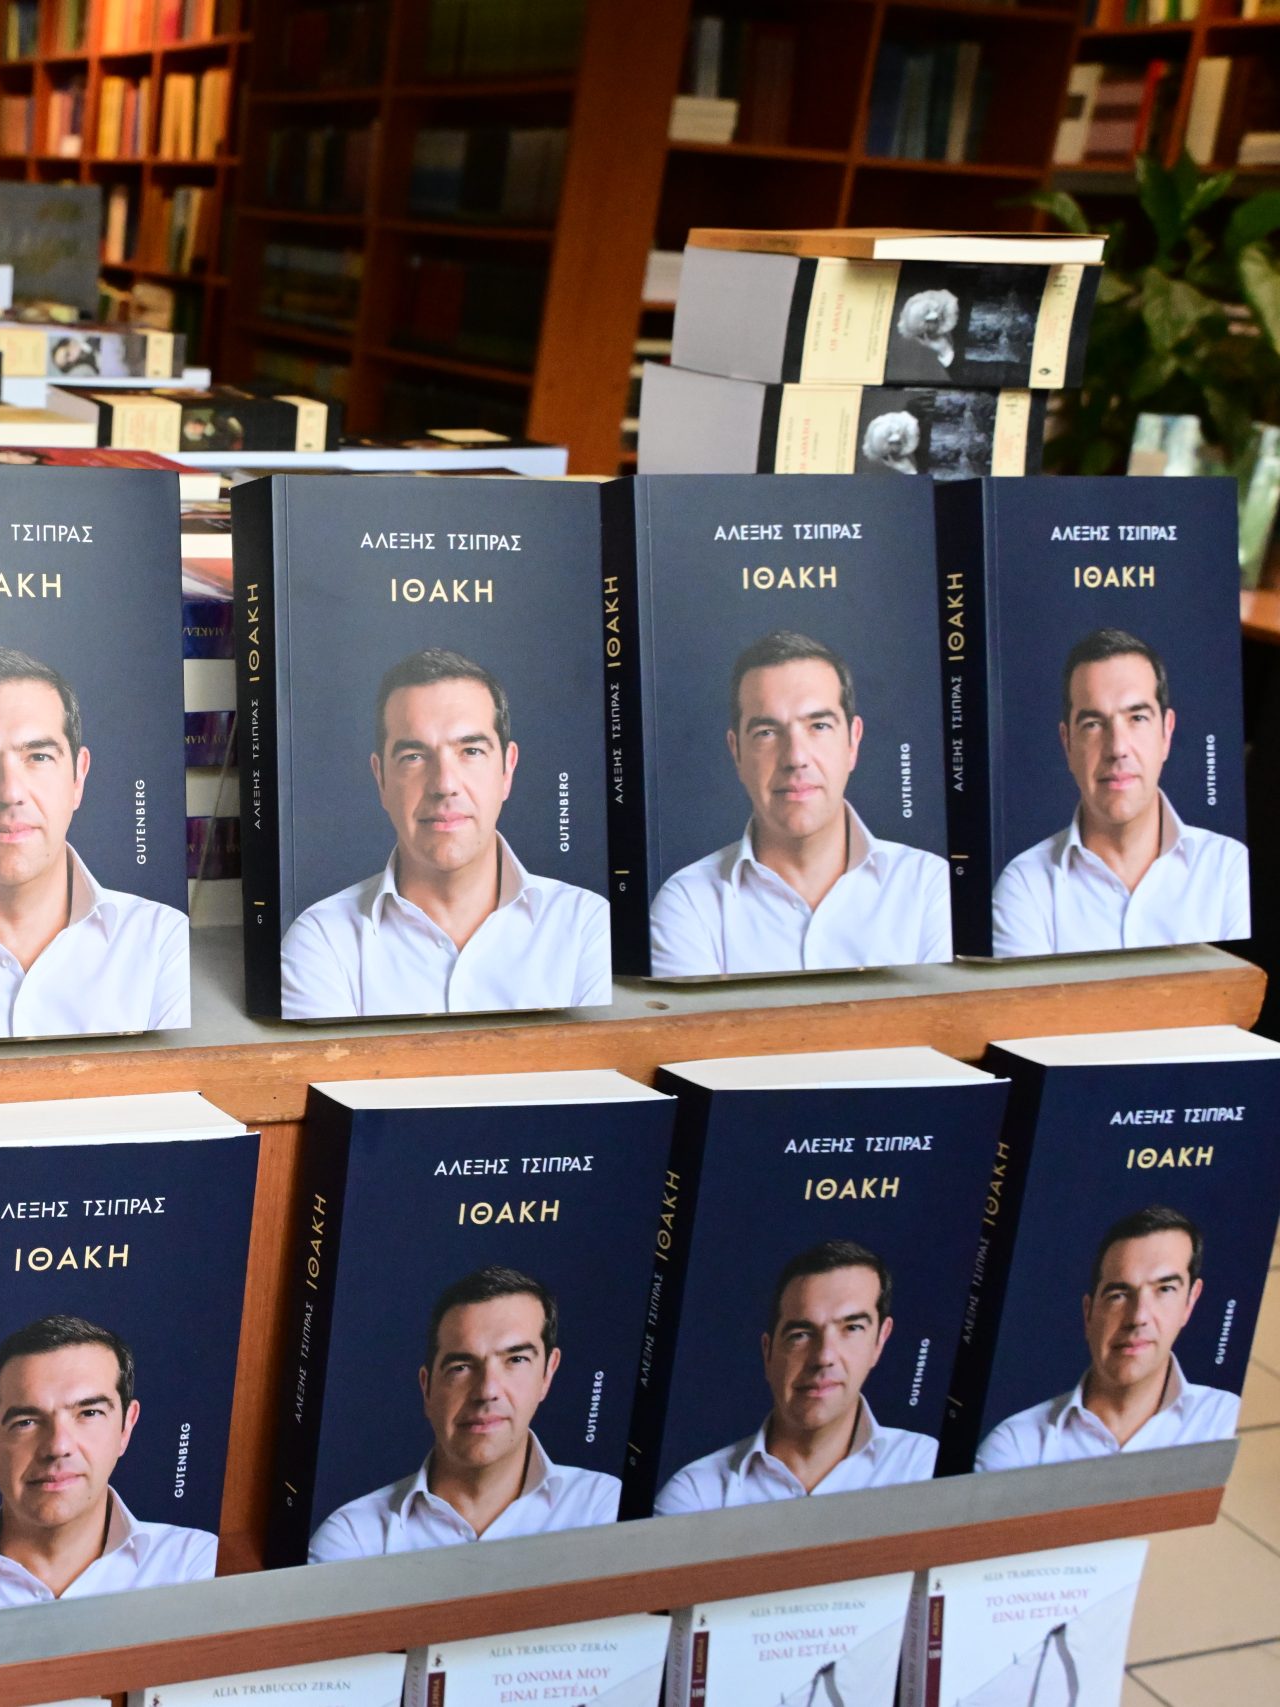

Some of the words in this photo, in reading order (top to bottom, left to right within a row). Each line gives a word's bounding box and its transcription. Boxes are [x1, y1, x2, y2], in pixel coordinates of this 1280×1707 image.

[11, 524, 93, 542] ΤΣΙΠΡΑΣ
[361, 533, 435, 549] ΑΛΕΞΗΣ
[447, 534, 521, 551] ΤΣΙΠΡΑΣ
[714, 525, 783, 540] ΑΛΕΞΗΣ
[793, 524, 862, 539] ΤΣΙΠΡΑΣ
[1051, 526, 1110, 541] ΑΛΕΞΗΣ
[1118, 526, 1177, 540] ΤΣΙΠΡΑΣ
[392, 579, 492, 602] ΙΘΑΚΗ
[743, 566, 836, 589] ΙΘΑΚΗ
[1075, 566, 1154, 588] ΙΘΑΚΗ
[246, 583, 260, 682] ΙΘΑΚΗ
[603, 576, 622, 668] ΙΘΑΚΗ
[946, 573, 965, 661] ΙΘΑΚΗ
[251, 698, 260, 760] ΤΣΙΠΡΑΣ
[610, 682, 621, 740] ΤΣΙΠΡΑΣ
[950, 675, 963, 730] ΤΣΙΠΡΑΣ
[612, 748, 624, 804] ΑΛΕΞΗΣ
[901, 743, 912, 818] GUTENBERG
[952, 738, 964, 792] ΑΛΕΞΗΣ
[1206, 735, 1216, 805] GUTENBERG
[136, 780, 146, 864] GUTENBERG
[252, 769, 261, 830] ΑΛΕΞΗΣ
[559, 772, 569, 852] GUTENBERG
[1110, 1109, 1175, 1124] ΑΛΕΞΗΣ
[1184, 1107, 1245, 1123] ΤΣΙΠΡΑΣ
[434, 1159, 509, 1175] ΑΛΕΞΗΣ
[521, 1156, 593, 1173] ΤΣΙΠΡΑΣ
[785, 1138, 855, 1153] ΑΛΕΞΗΣ
[866, 1136, 933, 1152] ΤΣΙΠΡΑΣ
[1127, 1146, 1213, 1168] ΙΘΑΚΗ
[83, 1197, 165, 1216] ΤΣΙΠΡΑΣ
[805, 1177, 899, 1200] ΙΘΑΚΗ
[983, 1142, 1010, 1226] ΙΘΑΚΗ
[459, 1200, 559, 1225] ΙΘΑΚΗ
[655, 1170, 680, 1261] ΙΘΑΚΗ
[15, 1244, 128, 1271] ΙΘΑΚΗ
[306, 1193, 327, 1290] ΙΘΑΚΗ
[300, 1301, 313, 1359] ΤΣΙΠΡΑΣ
[1215, 1300, 1236, 1364] GUTENBERG
[295, 1365, 307, 1424] ΑΛΕΞΗΣ
[909, 1338, 930, 1406] GUTENBERG
[586, 1371, 604, 1442] GUTENBERG
[174, 1423, 190, 1498] GUTENBERG
[489, 1648, 514, 1658] ALIA
[517, 1642, 577, 1656] TRABUCCO
[493, 1673, 513, 1687] ΤΟ
[517, 1670, 573, 1684] ΟΝΟΜΑ
[576, 1667, 611, 1680] ΜΟΥ
[212, 1687, 238, 1699] ALIA
[242, 1682, 307, 1695] TRABUCCO
[311, 1678, 352, 1692] ZERÁN
[500, 1689, 539, 1704] ΕΙΝΑΙ
